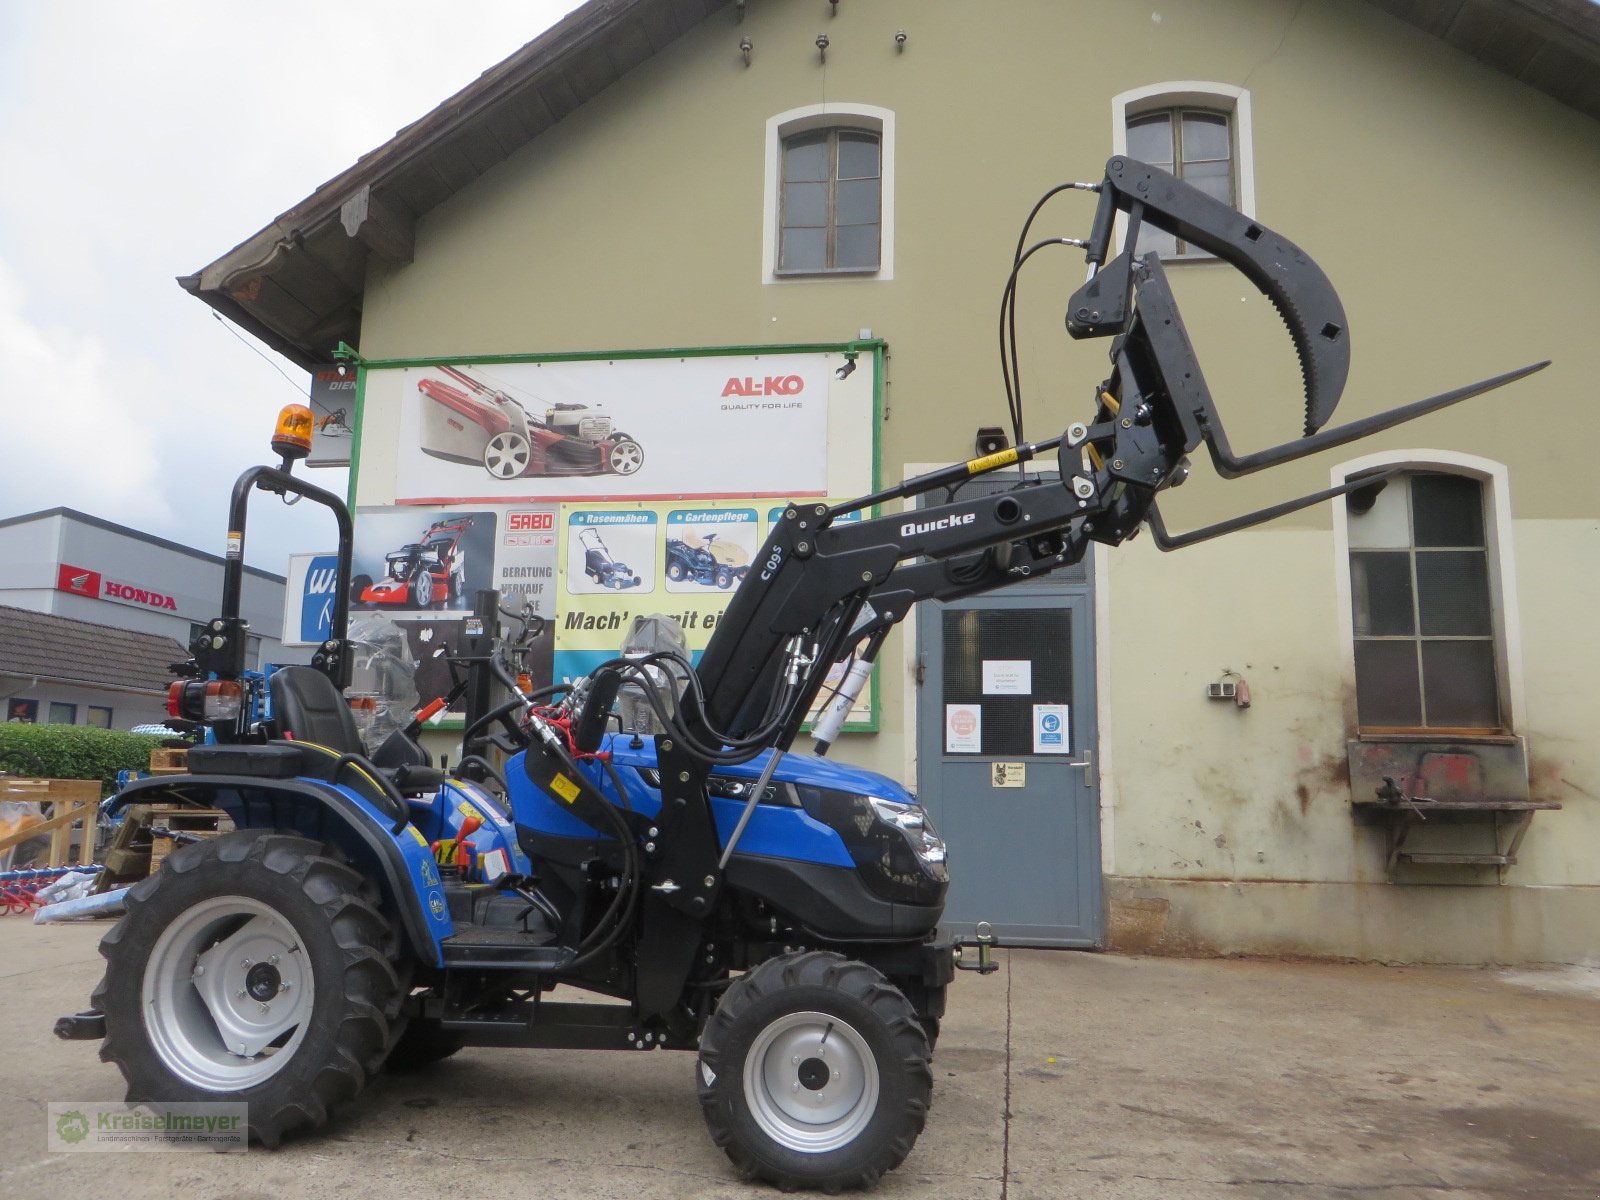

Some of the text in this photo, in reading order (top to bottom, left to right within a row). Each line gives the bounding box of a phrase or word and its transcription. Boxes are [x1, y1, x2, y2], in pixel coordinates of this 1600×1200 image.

[721, 375, 804, 397] AL-KO
[720, 403, 760, 411] QUALITY
[510, 514, 553, 530] SABO
[586, 514, 649, 524] Rasenmähen
[685, 512, 749, 523] Gartenpflege
[901, 513, 976, 537] Quicke
[502, 566, 553, 578] BERATUNG
[501, 583, 544, 595] VERKAUF
[105, 581, 177, 611] HONDA
